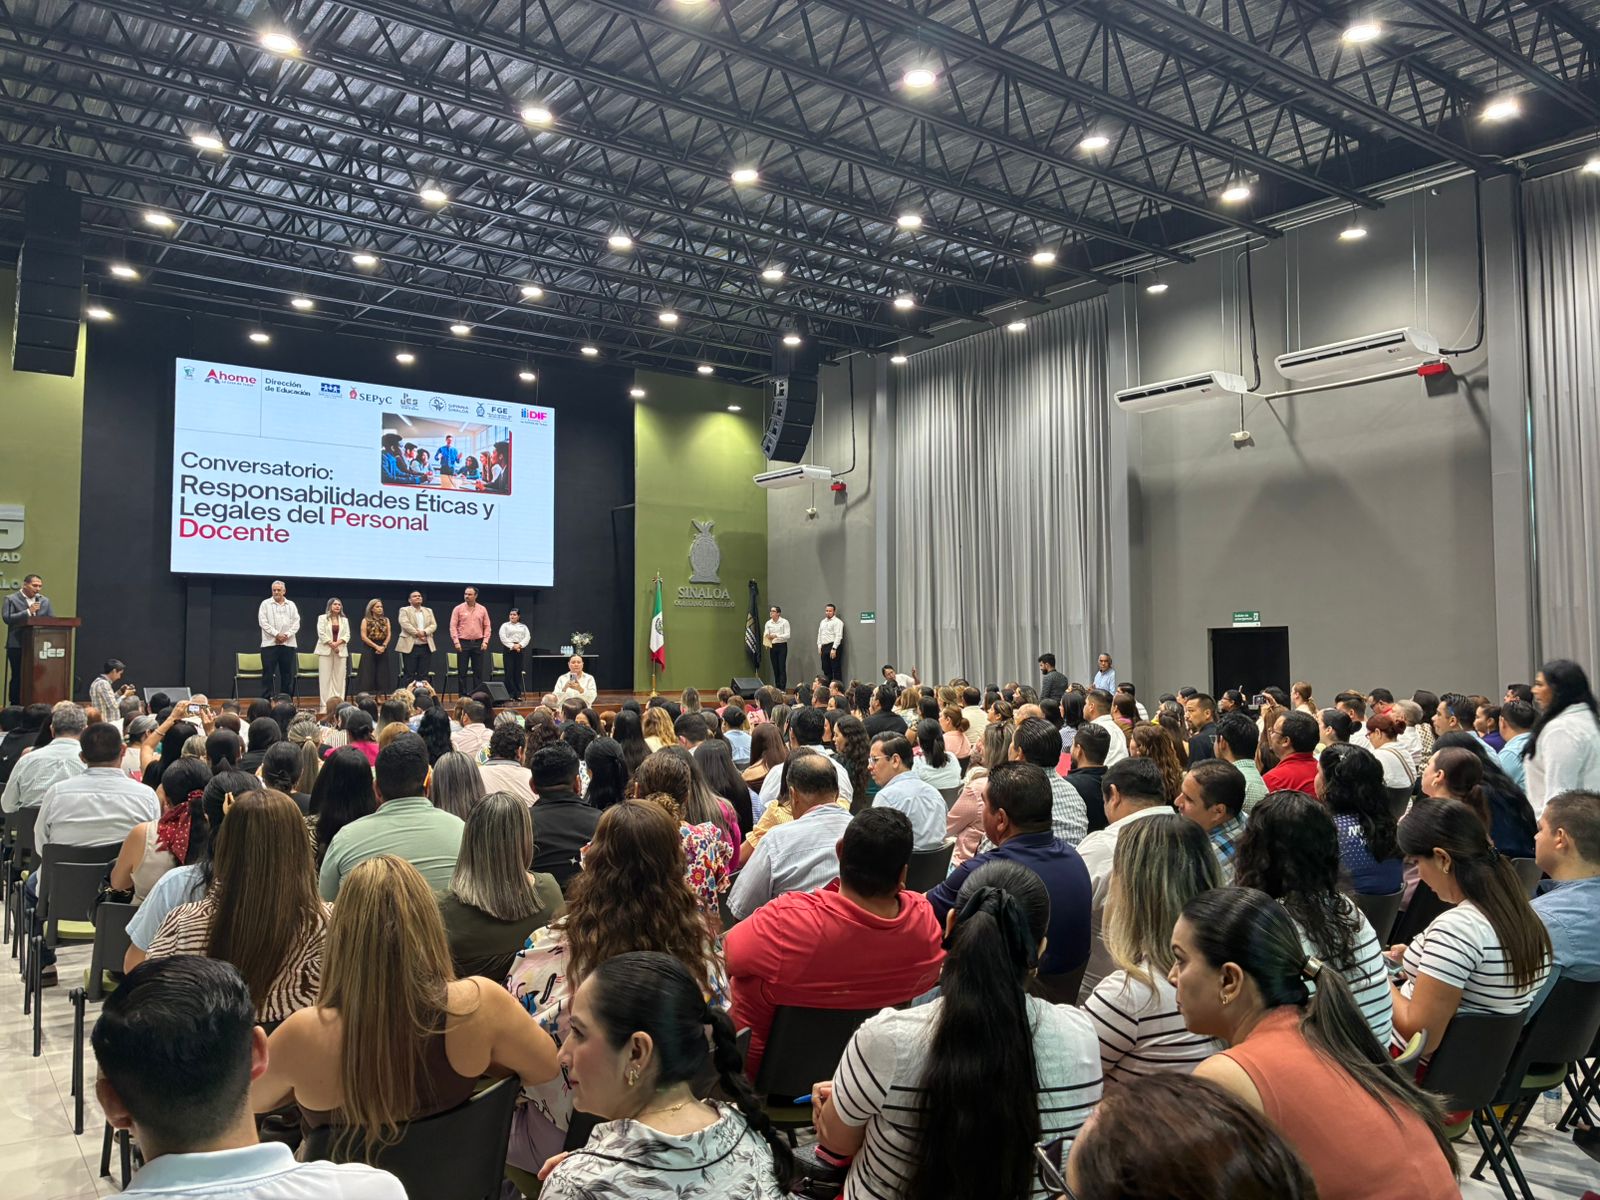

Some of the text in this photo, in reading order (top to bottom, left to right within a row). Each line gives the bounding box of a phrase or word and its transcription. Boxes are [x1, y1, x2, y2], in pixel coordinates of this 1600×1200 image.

[204, 369, 257, 384] Ahome
[265, 377, 302, 389] Dirección
[276, 387, 311, 397] Educación
[359, 393, 393, 406] SEPyC
[491, 406, 508, 415] FGE
[529, 410, 548, 420] DIF
[181, 451, 334, 481] Conversatorio:
[180, 474, 494, 521] Responsabilidades Éticas y
[179, 496, 429, 532] Legales del Personal
[179, 518, 290, 544] Docente
[678, 586, 730, 599] SINALOA
